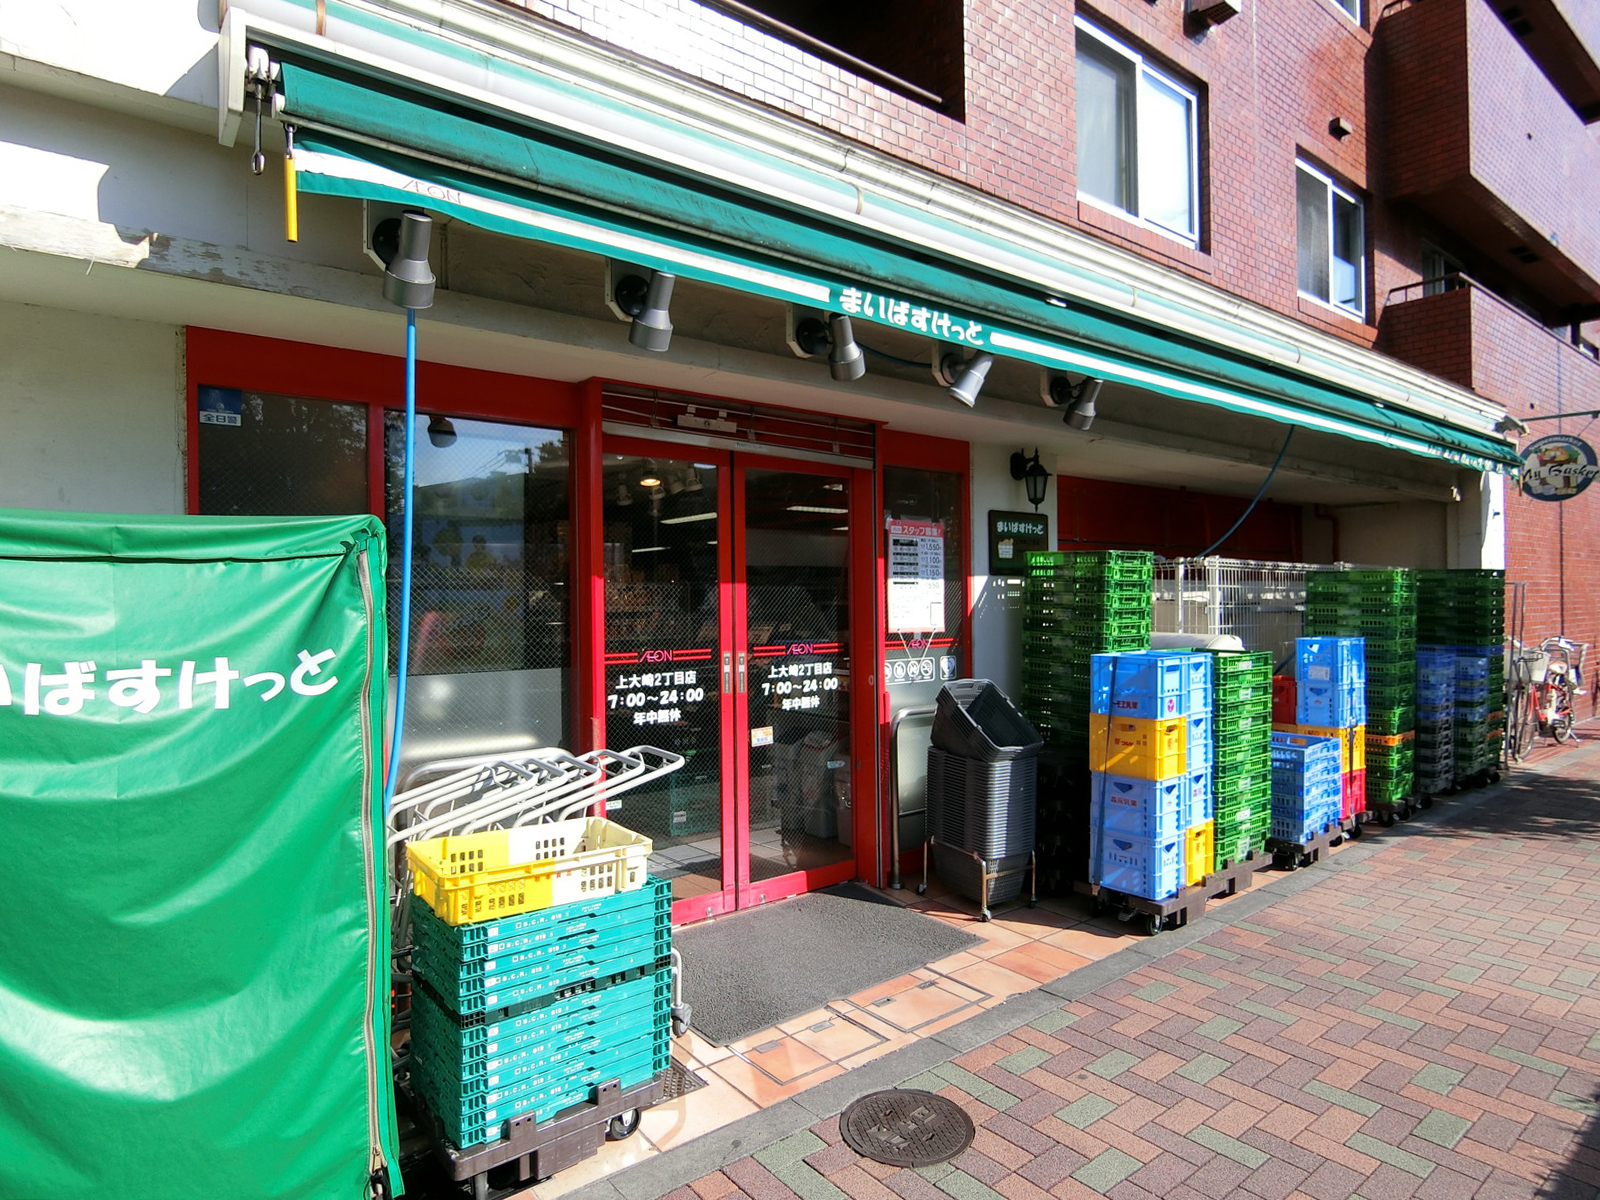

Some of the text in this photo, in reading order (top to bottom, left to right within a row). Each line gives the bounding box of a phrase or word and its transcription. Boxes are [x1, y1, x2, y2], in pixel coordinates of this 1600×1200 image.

[839, 287, 984, 346] まいばすけっと
[996, 520, 1045, 535] まいばすけっと
[781, 695, 820, 711] 年中無休
[633, 708, 681, 726] 年中無休
